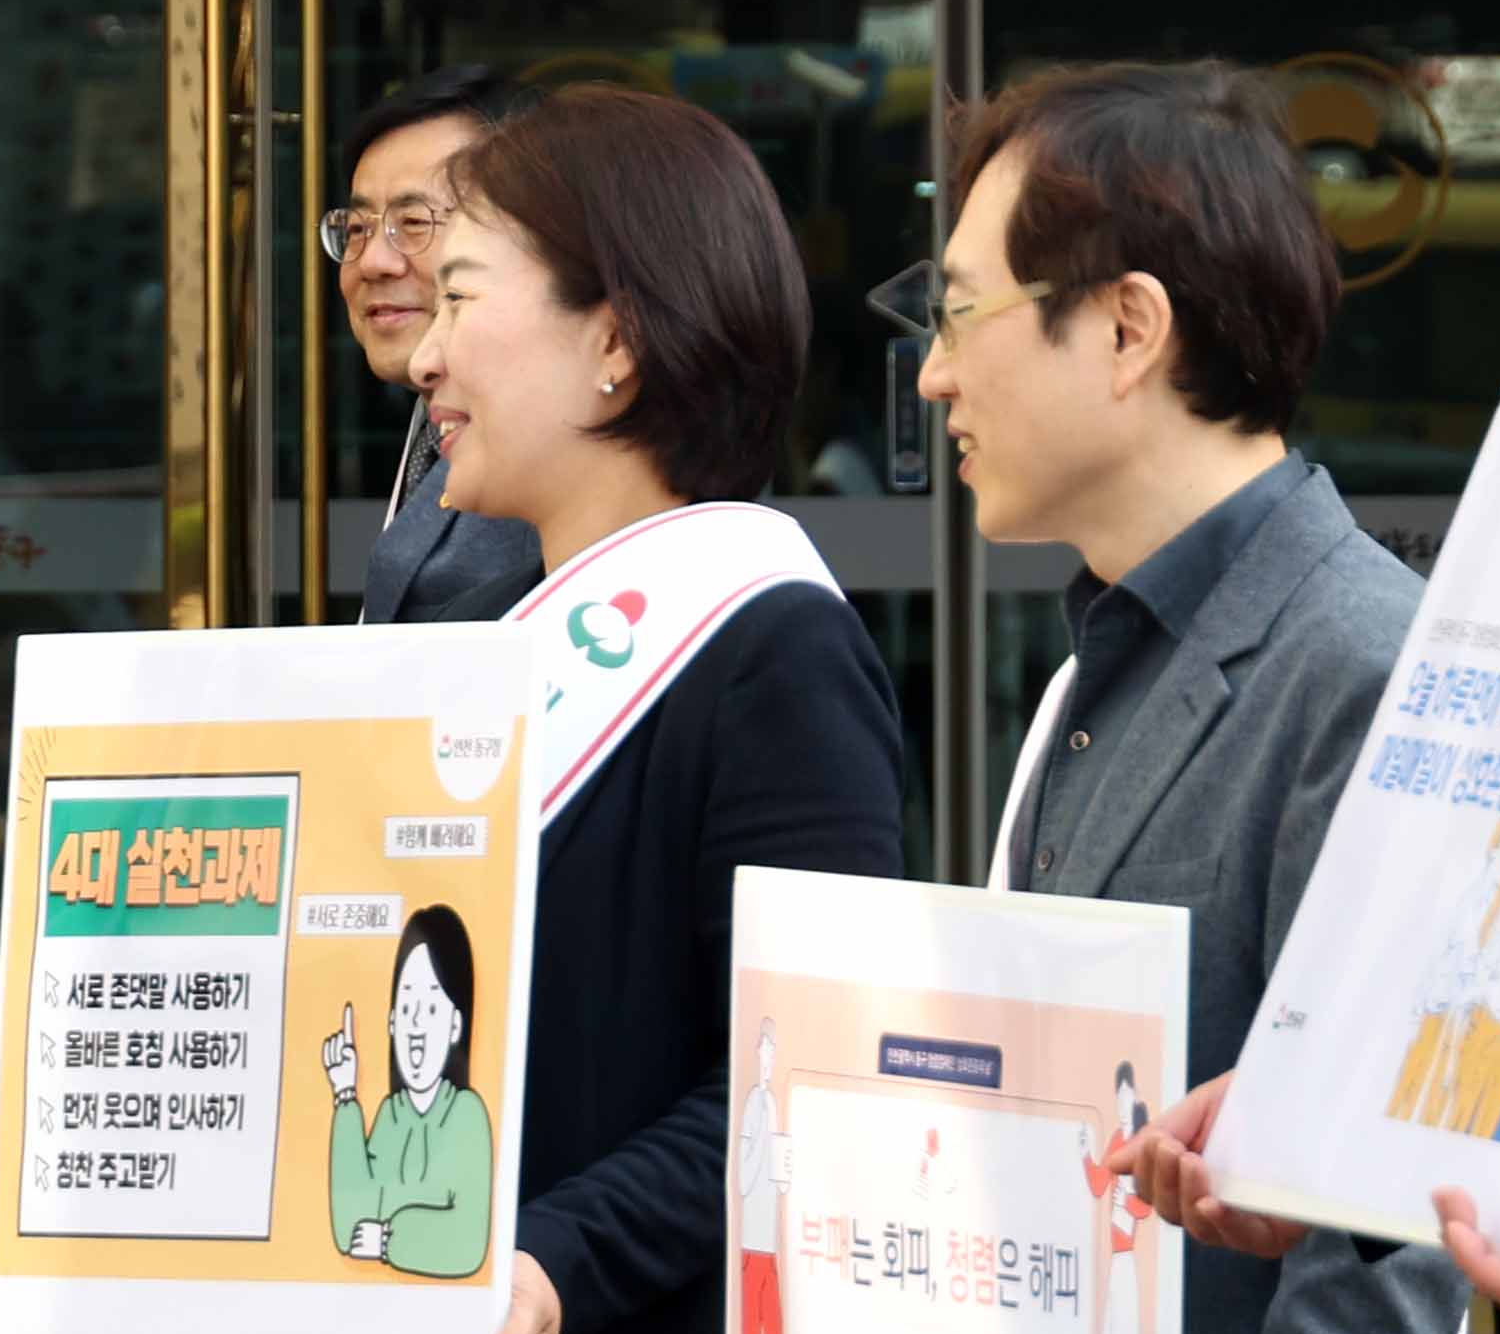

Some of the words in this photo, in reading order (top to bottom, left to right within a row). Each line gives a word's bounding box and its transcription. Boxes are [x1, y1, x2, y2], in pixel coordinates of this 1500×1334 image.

[48, 828, 119, 906] 4대
[125, 824, 284, 908] 실천과제
[343, 902, 393, 929] 존중해요
[66, 975, 105, 1011] 서로
[109, 974, 167, 1012] 존댓말
[171, 972, 251, 1011] 사용하기
[64, 1032, 121, 1068] 올바른
[124, 1032, 164, 1068] 호칭
[169, 1031, 248, 1068] 사용하기
[62, 1095, 98, 1131] 먼저
[103, 1094, 162, 1130] 웃으며
[168, 1093, 244, 1130] 인사하기
[56, 1153, 92, 1190] 칭찬
[97, 1152, 176, 1190] 주고받기
[798, 1211, 874, 1289] 부패는
[880, 1220, 939, 1299] 회피,
[944, 1229, 1023, 1313] 청렴은
[1027, 1241, 1080, 1321] 해피
